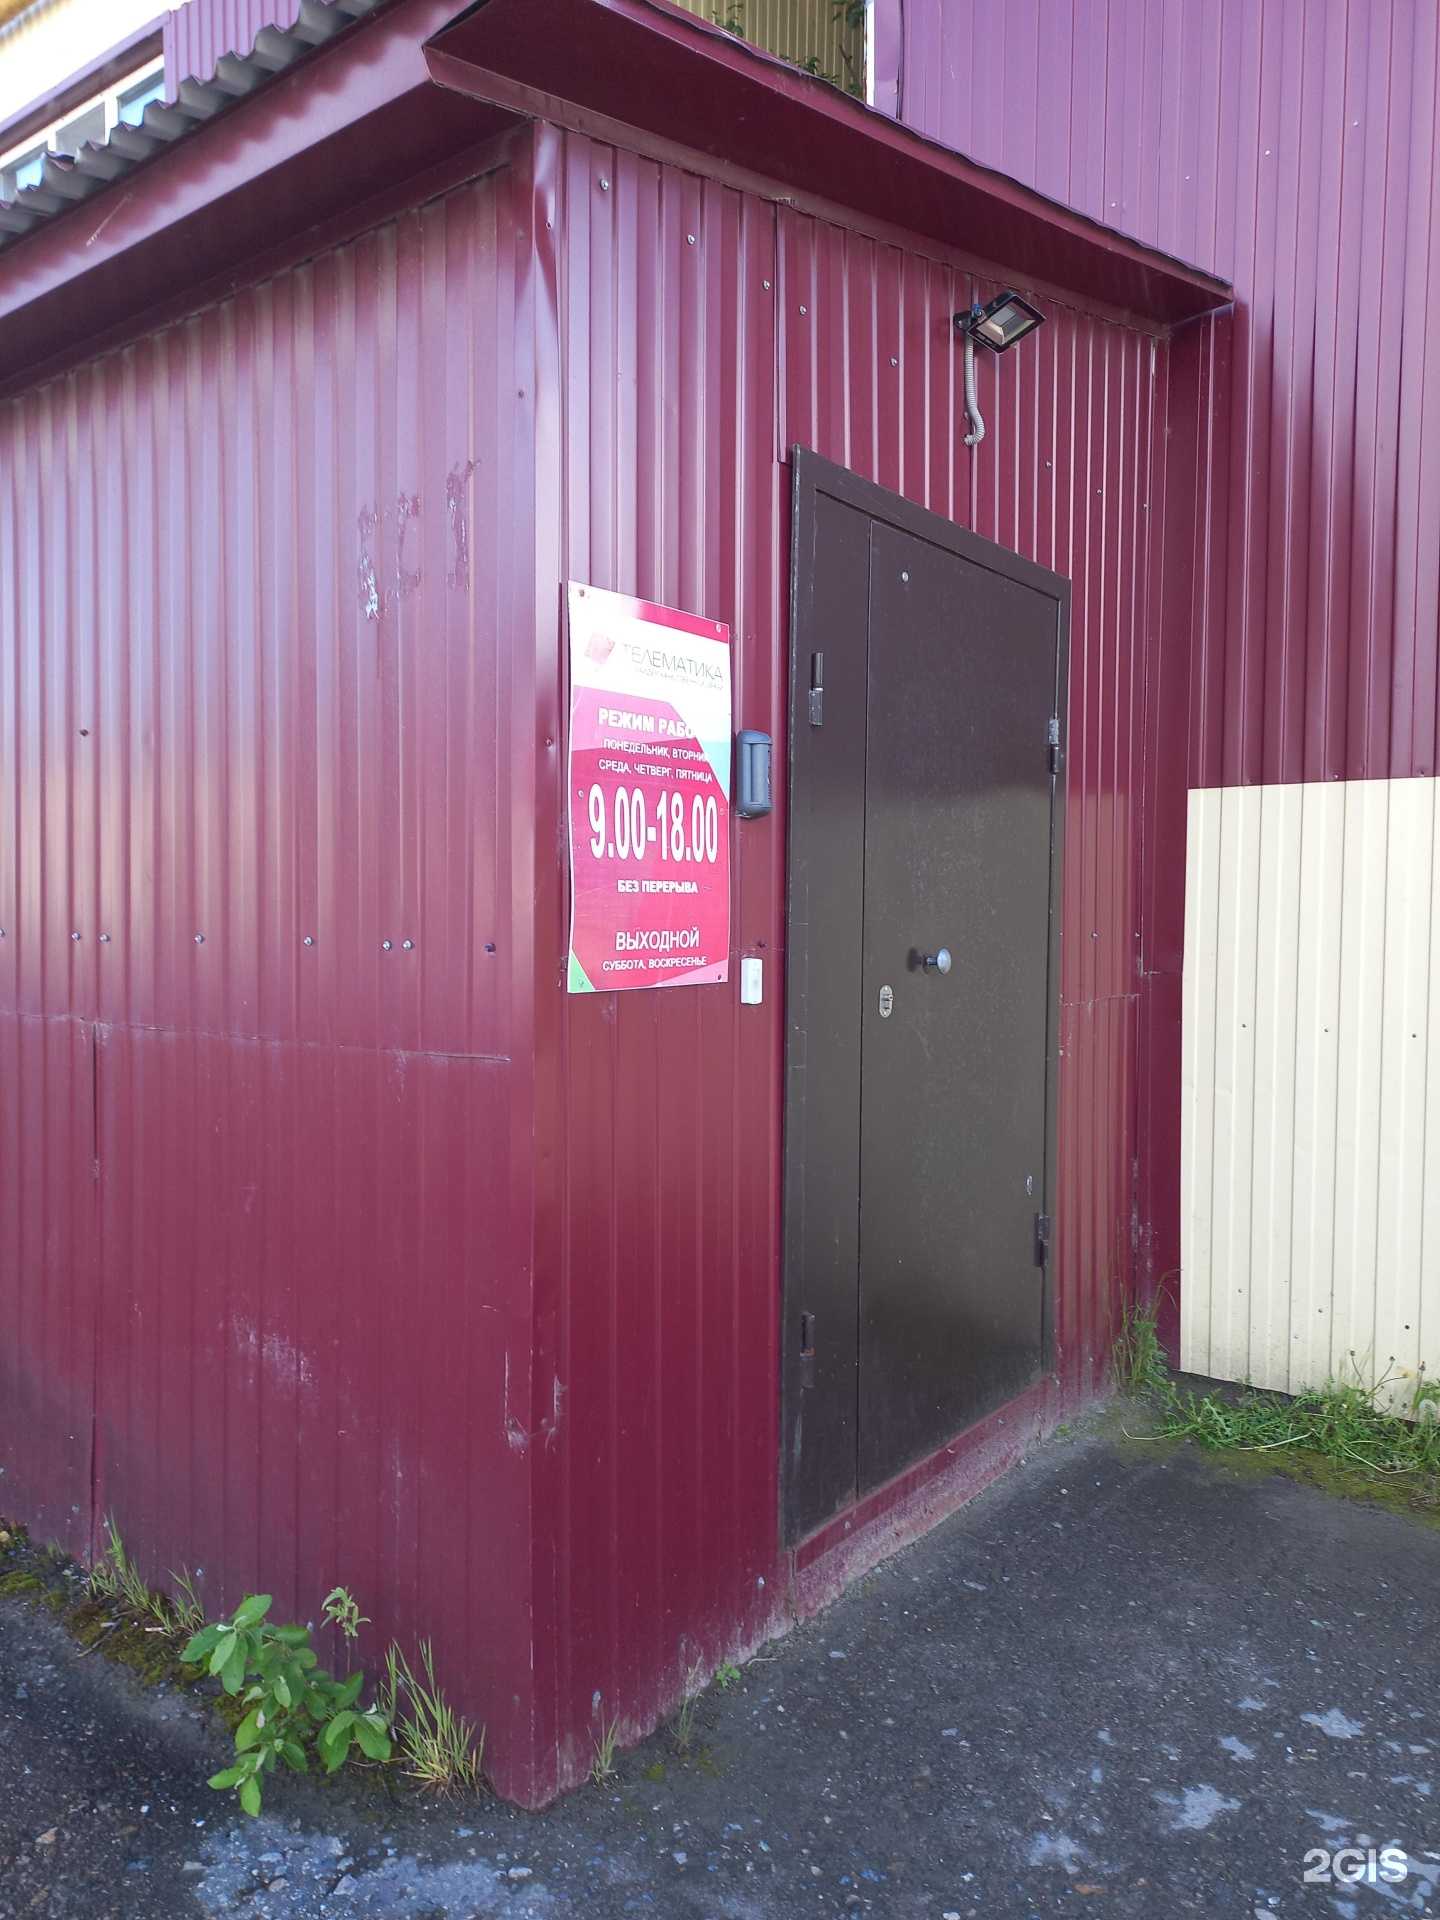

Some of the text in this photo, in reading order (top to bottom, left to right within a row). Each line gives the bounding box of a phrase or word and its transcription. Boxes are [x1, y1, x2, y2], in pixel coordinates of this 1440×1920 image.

[622, 641, 723, 680] ТЕЛЕМАТИКА
[598, 707, 696, 738] РЕЖИМ РАБО
[603, 738, 671, 758] ПОНЕДЕЛЬНИК,
[598, 759, 713, 784] СРЕДА, ЧЕТВЕРГ, ПЯТНИЦА
[588, 783, 718, 863] 9.00-18.00
[617, 879, 699, 894] БЕЗ ПЕРЕРЫВА
[615, 927, 700, 952] ВЫХОДНОЙ
[602, 956, 708, 972] СУББОТА, ВОСКРЕСЕНЬЕ
